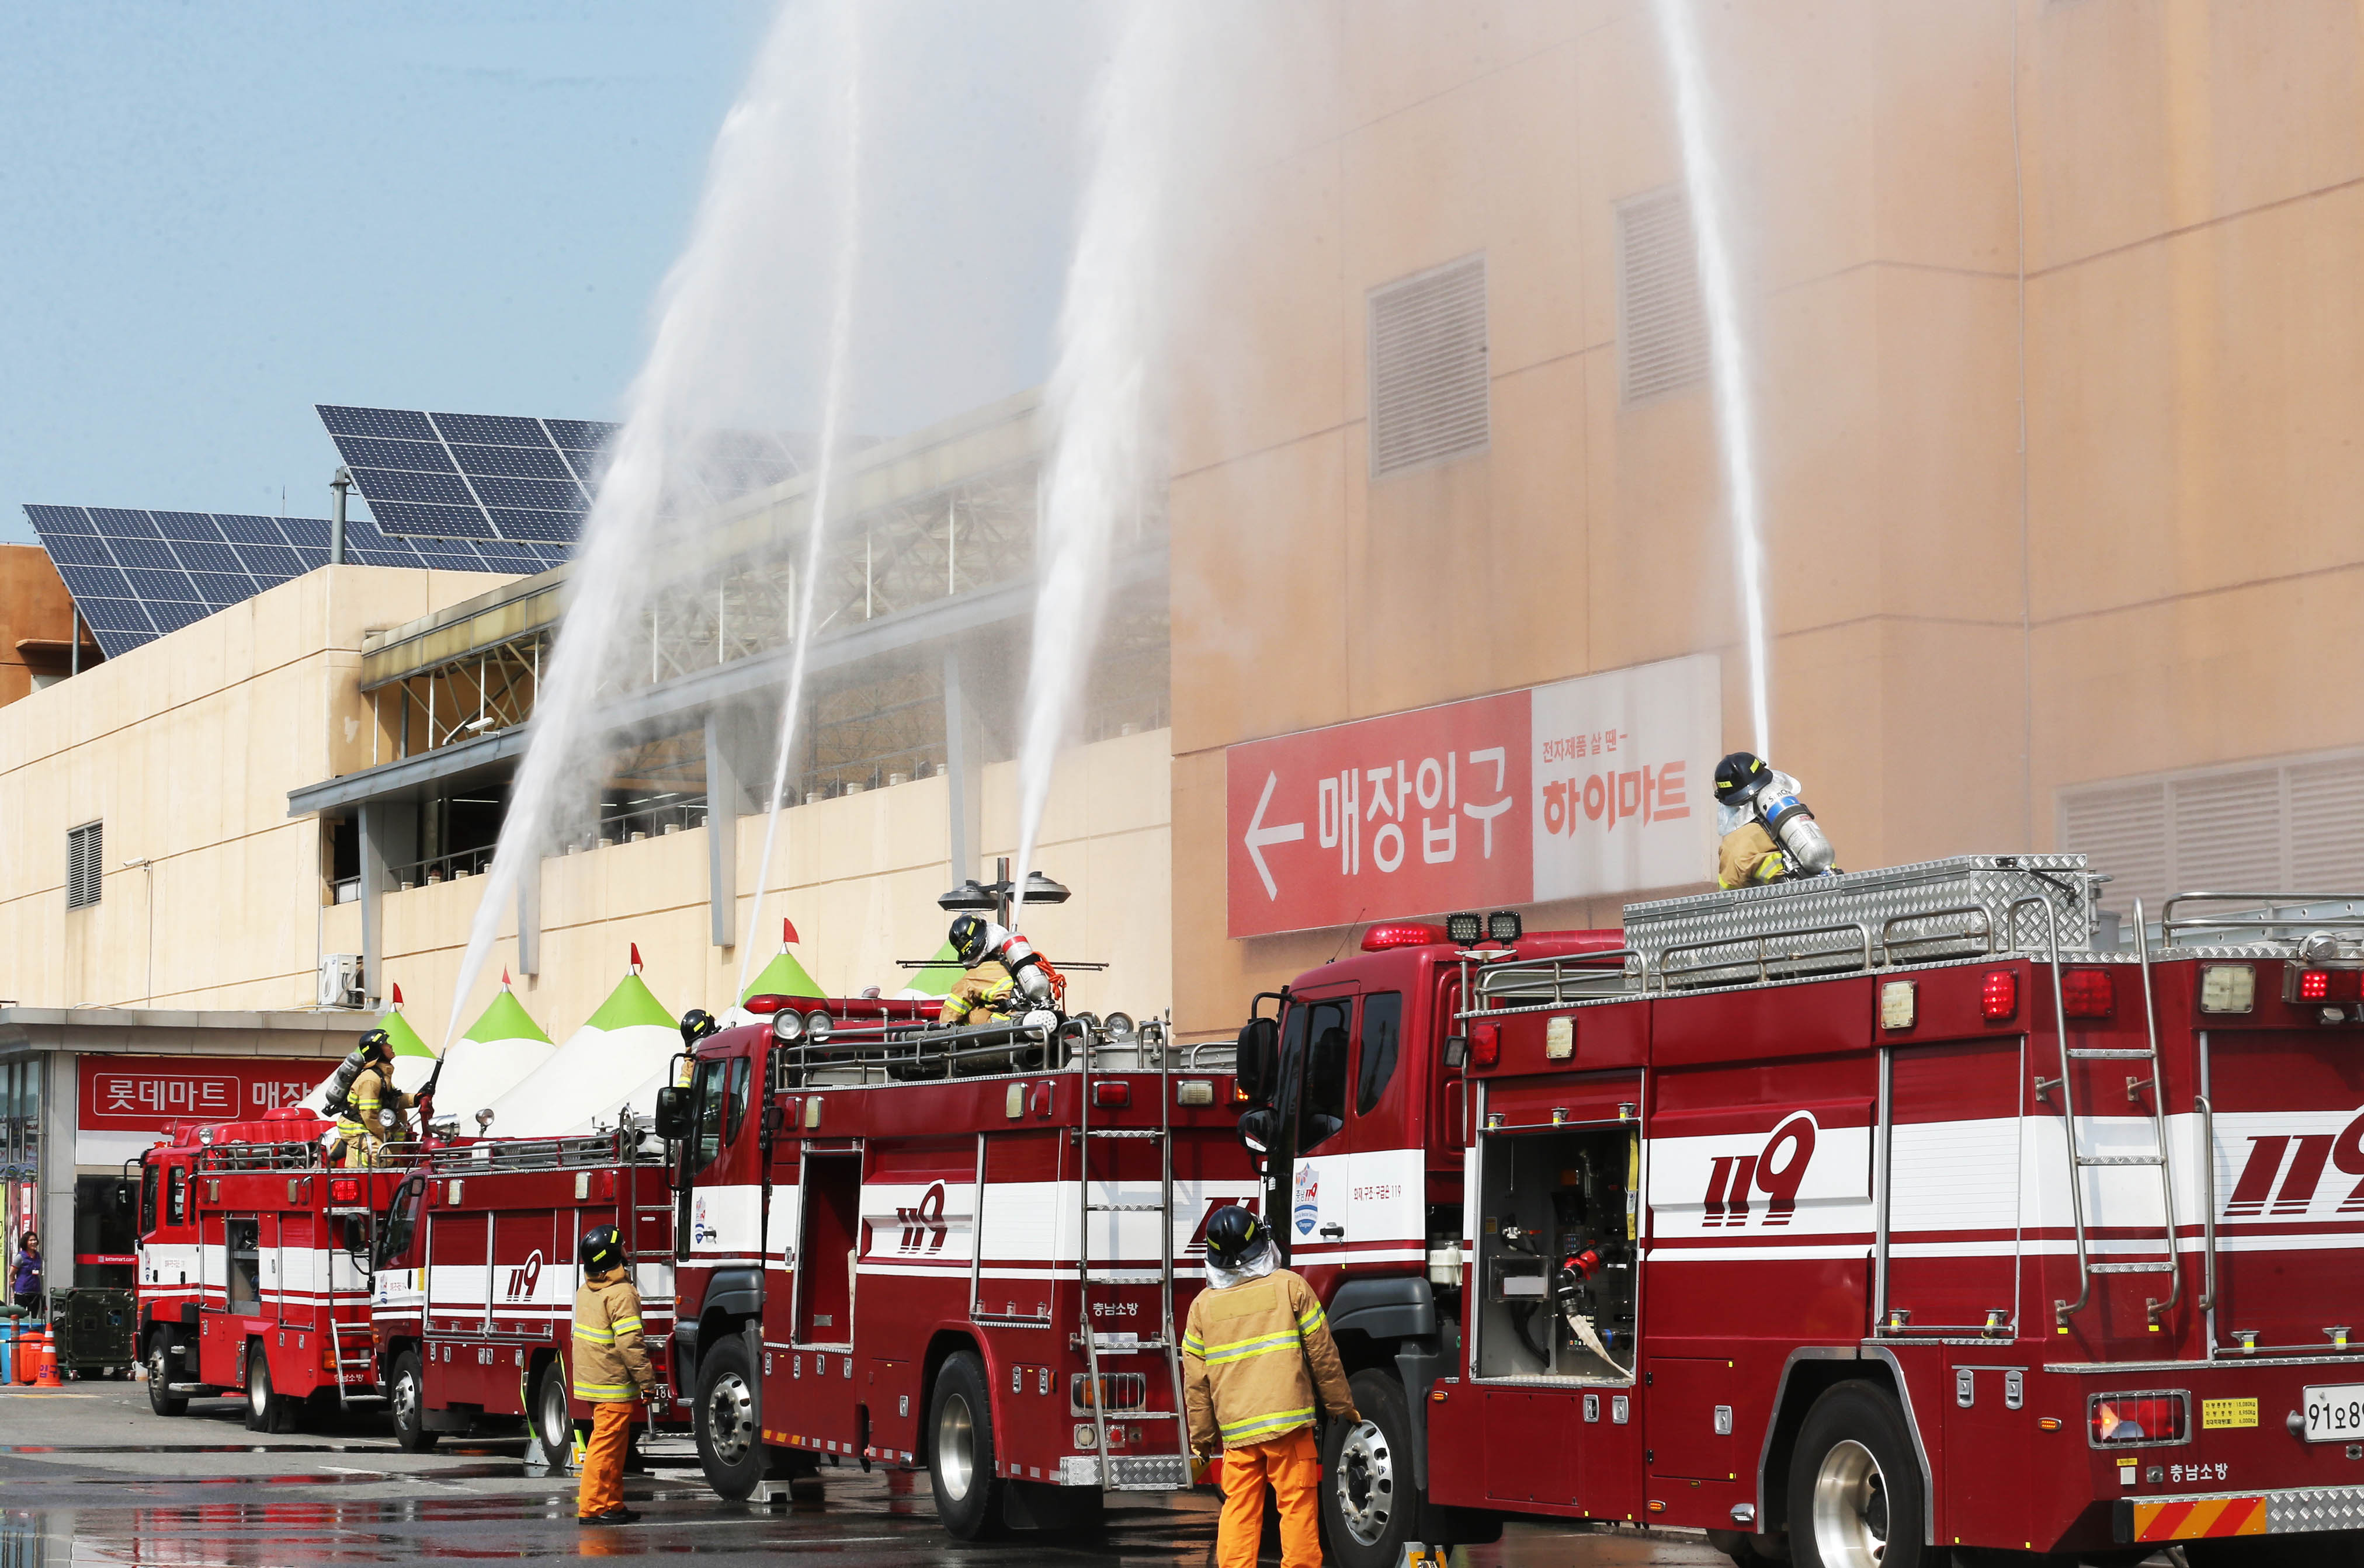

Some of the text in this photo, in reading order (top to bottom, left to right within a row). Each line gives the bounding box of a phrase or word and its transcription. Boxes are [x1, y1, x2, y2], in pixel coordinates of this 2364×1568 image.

[1543, 734, 1587, 763] 전자제품
[1590, 732, 1602, 756] 살
[1318, 746, 1513, 875] 매장입구
[1542, 760, 1691, 840] 하이마트
[107, 1079, 322, 1111] 롯데마트 매장
[1702, 1117, 1815, 1228] 119
[1391, 1184, 1401, 1197] 119
[895, 1183, 949, 1255] 119
[506, 1253, 541, 1302] 119
[1092, 1302, 1139, 1317] 충남소방
[39, 1364, 57, 1378] 입구
[2309, 1402, 2364, 1430] 91오8
[2169, 1462, 2228, 1483] 충남소방
